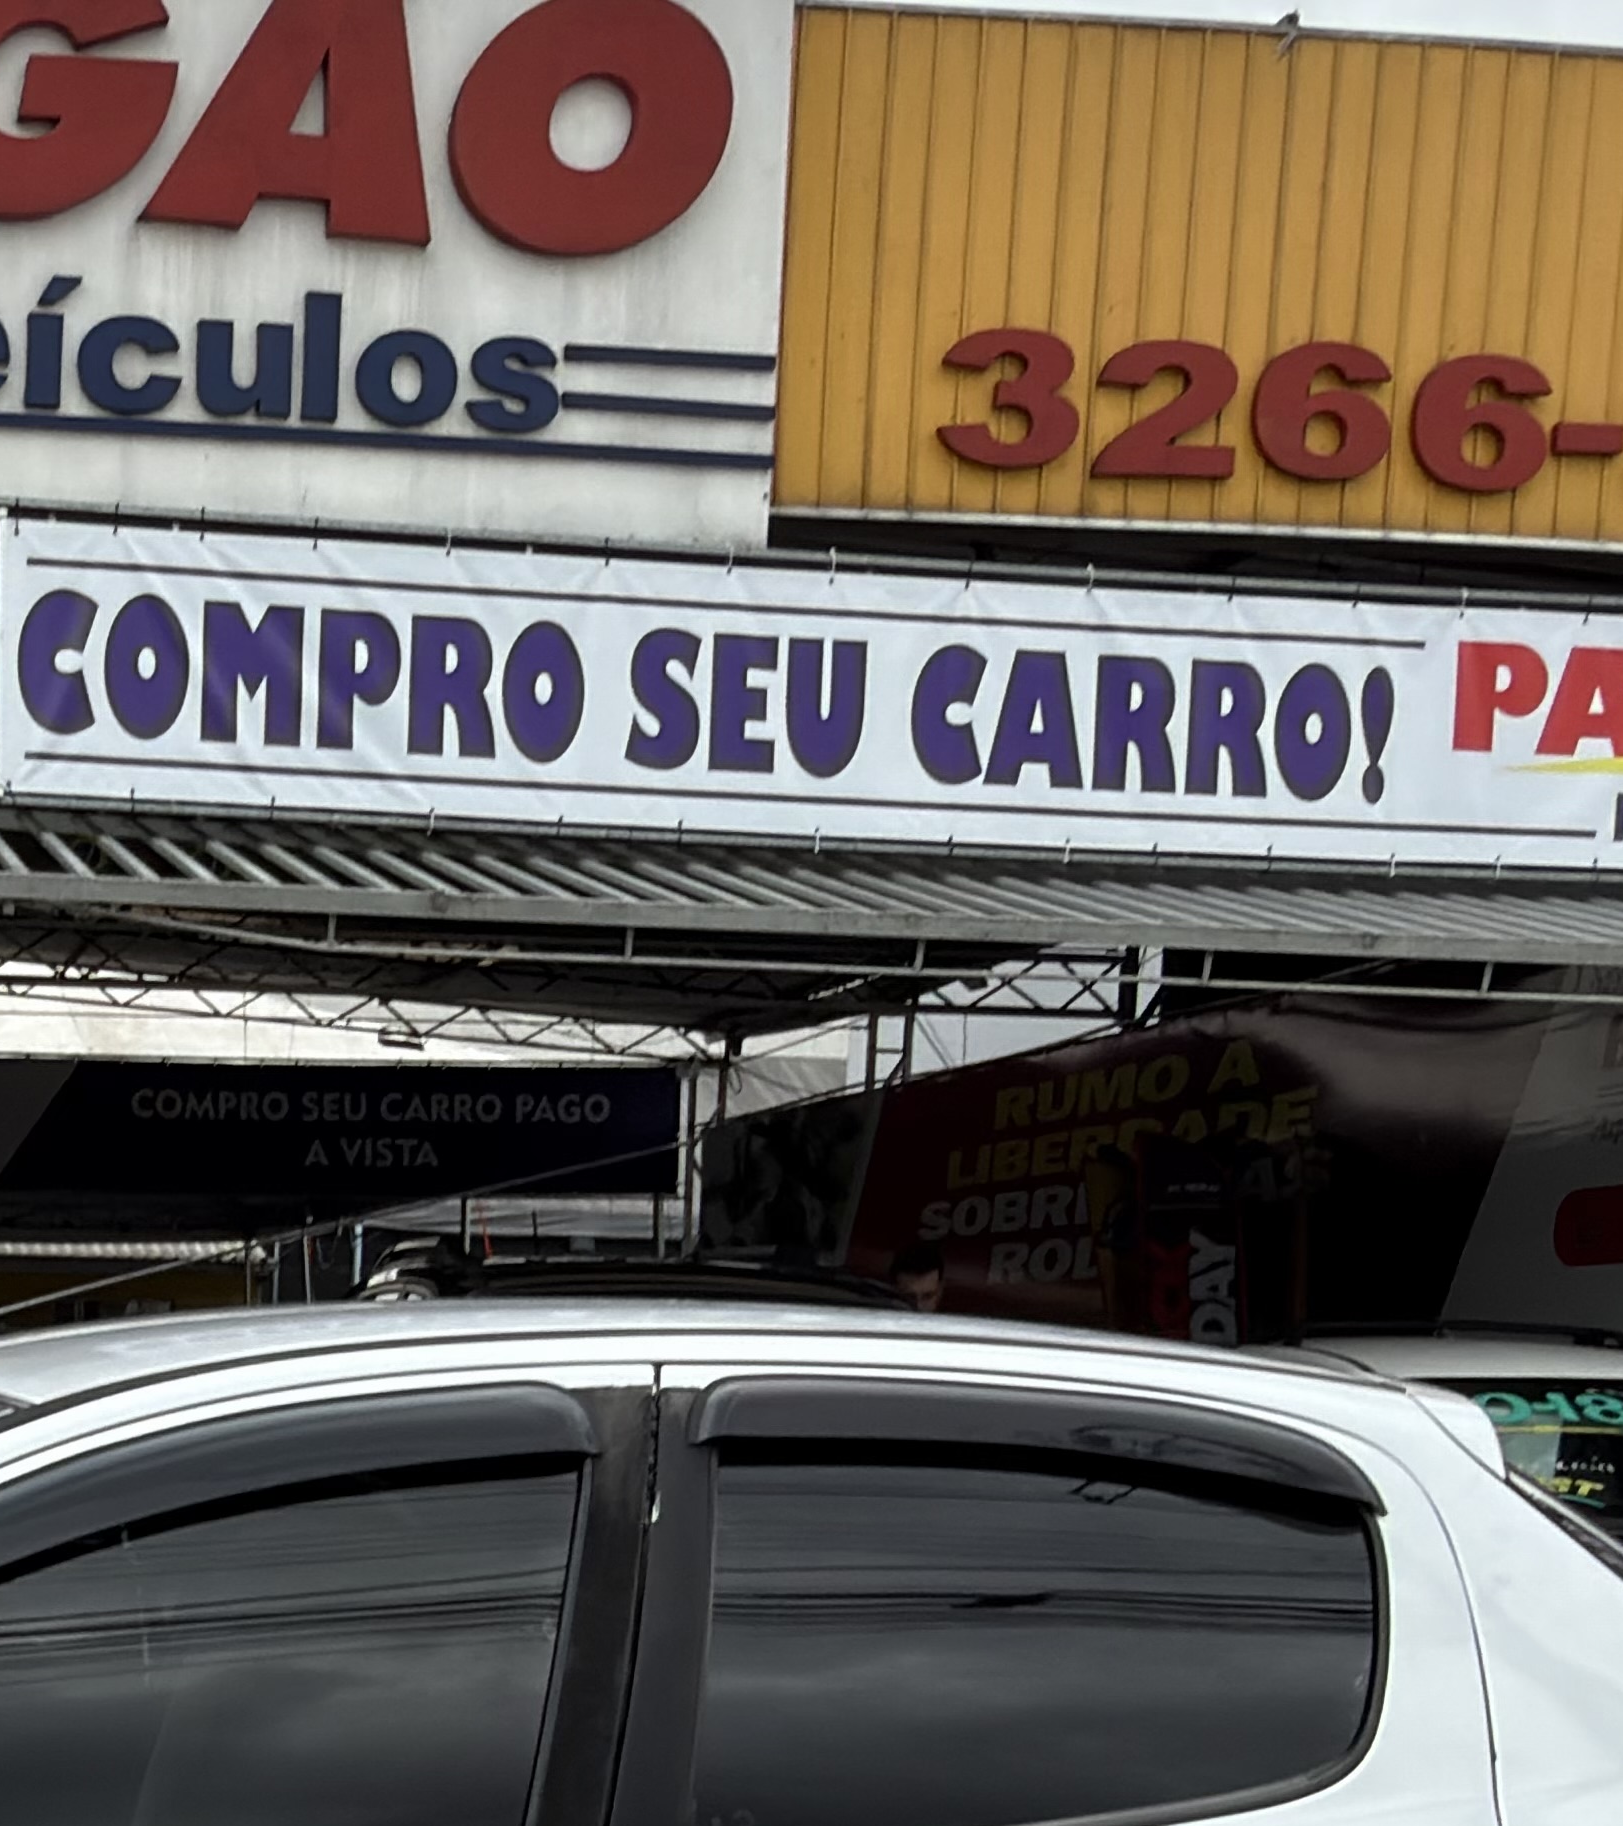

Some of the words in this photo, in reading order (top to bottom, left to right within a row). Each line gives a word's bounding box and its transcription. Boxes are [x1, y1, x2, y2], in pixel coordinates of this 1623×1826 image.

[16, 588, 585, 763] COMPRO
[627, 627, 867, 781] SEU
[908, 643, 1395, 805] CARRO!
[130, 1087, 290, 1122] COMPRO
[300, 1091, 369, 1122] SEU
[378, 1092, 504, 1125] CARRO
[514, 1093, 612, 1125] PAGO
[993, 1055, 1192, 1132] RUMO
[1206, 1037, 1262, 1094] A
[302, 1137, 331, 1169] A
[339, 1137, 440, 1169] VISTA
